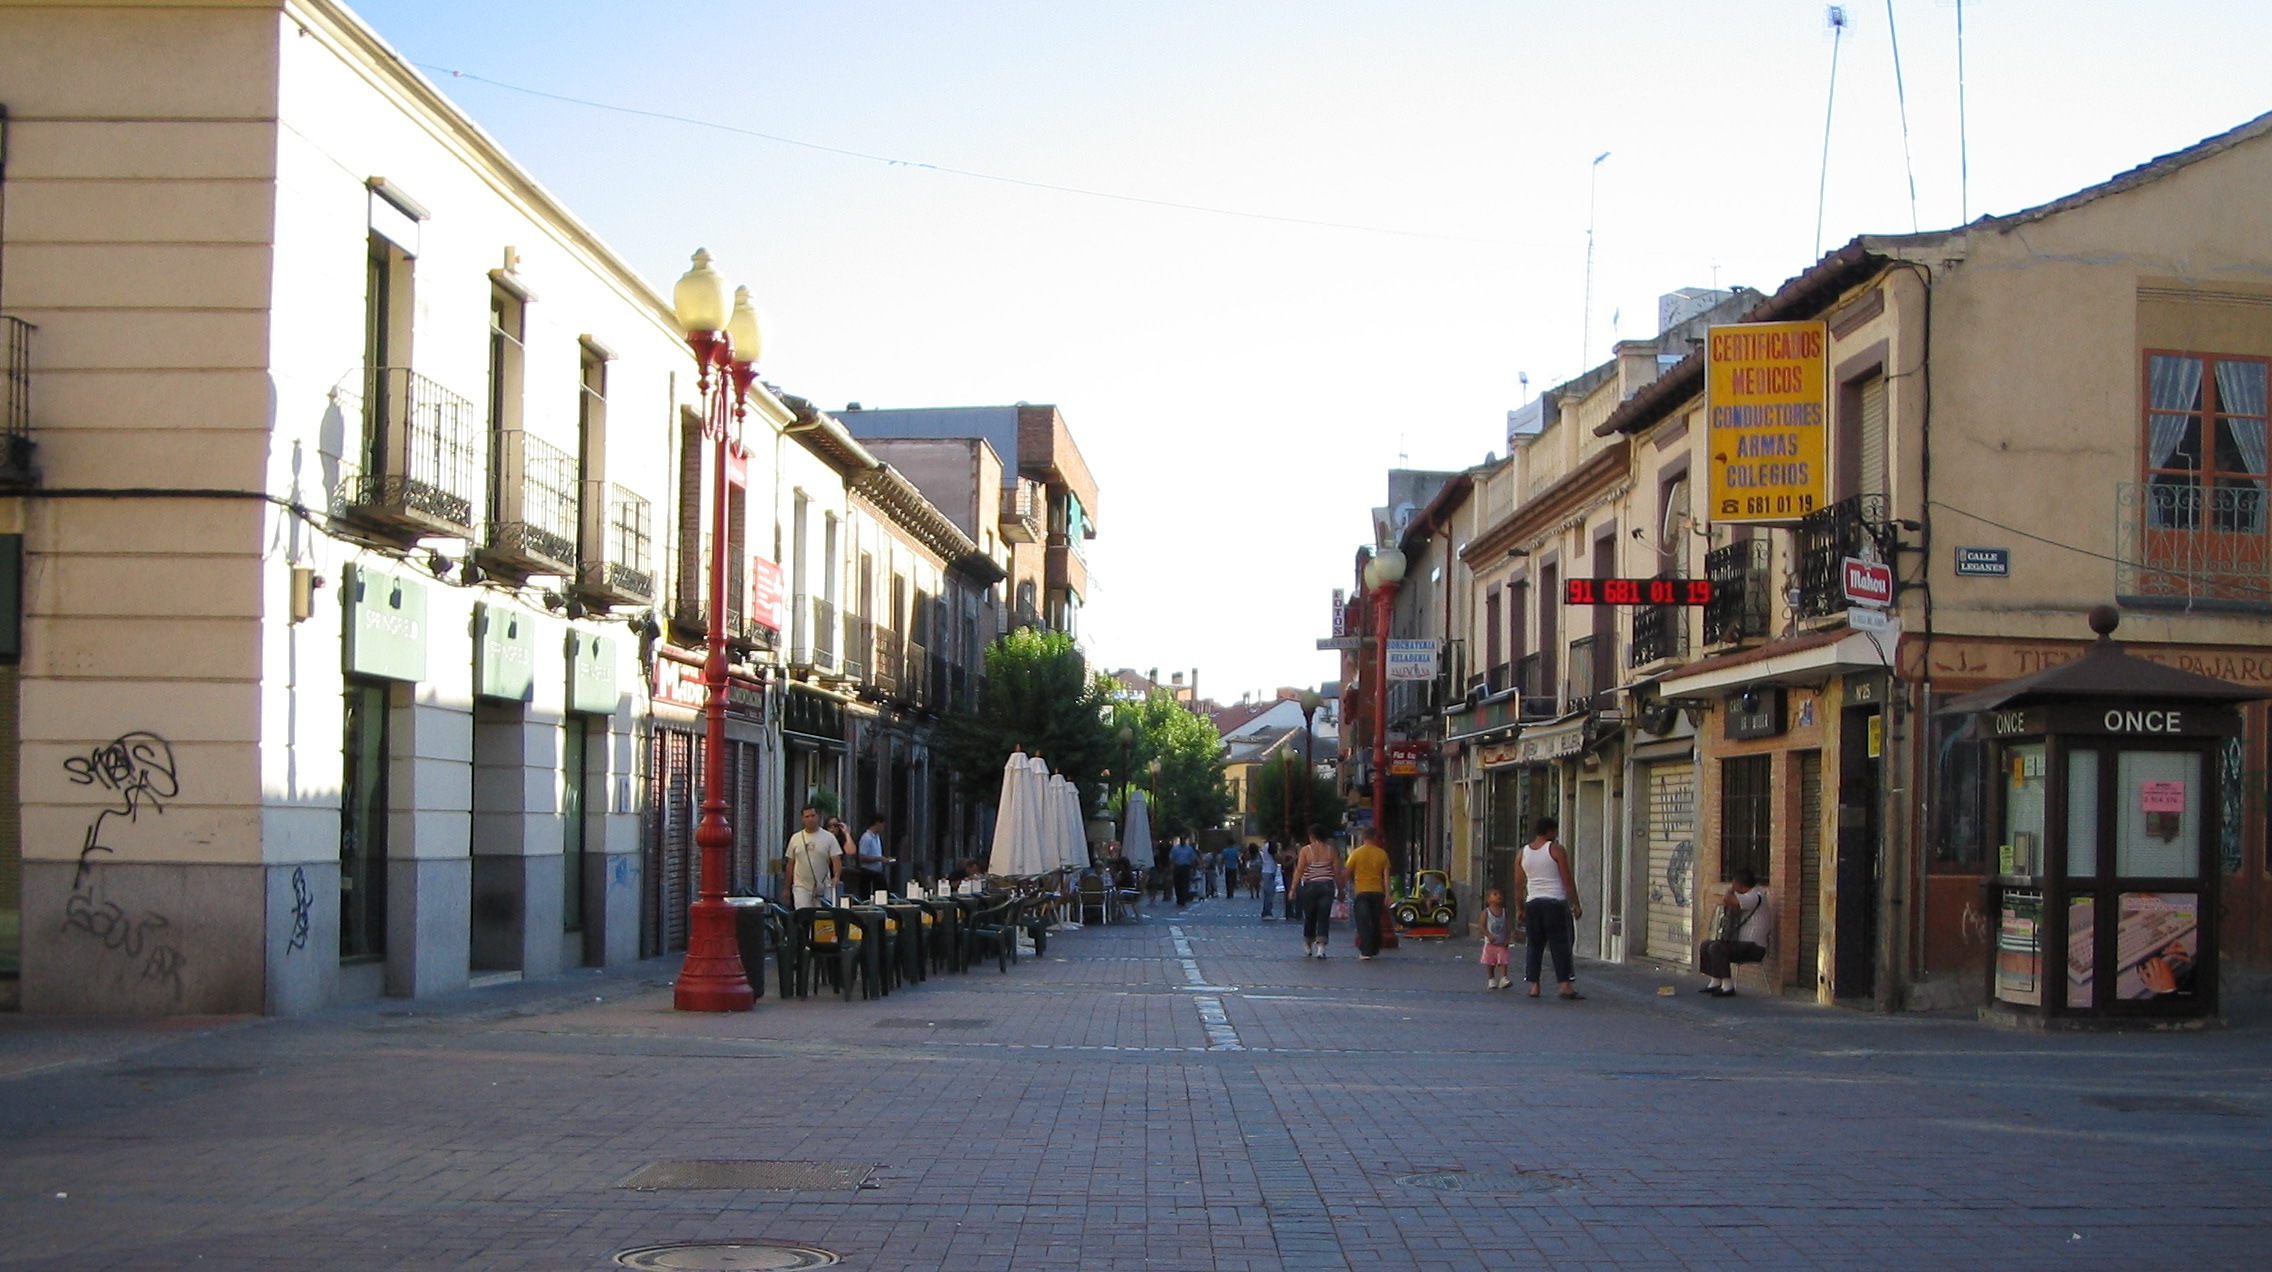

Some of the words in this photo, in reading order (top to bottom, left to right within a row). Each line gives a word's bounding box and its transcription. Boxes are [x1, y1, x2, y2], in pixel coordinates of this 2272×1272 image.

[1713, 332, 1821, 362] CERTIFICADOS
[1732, 366, 1803, 395] MEDICOS
[1713, 402, 1823, 428] CONDUCTORES
[1737, 434, 1799, 458] ARMAS
[1727, 462, 1809, 488] COLEGIOS
[1747, 496, 1770, 514] 681
[1777, 494, 1791, 512] 01
[1799, 493, 1813, 511] 19
[1967, 552, 1998, 561] CALLE
[1570, 580, 1594, 602] 91
[1604, 580, 1640, 602] 681
[1651, 580, 1674, 602] 01
[1687, 580, 1711, 602] 19
[1850, 569, 1887, 594] Mahou
[1334, 590, 1343, 636] FOTOS
[1996, 712, 2025, 734] ONCE
[2104, 710, 2182, 733] ONCE
